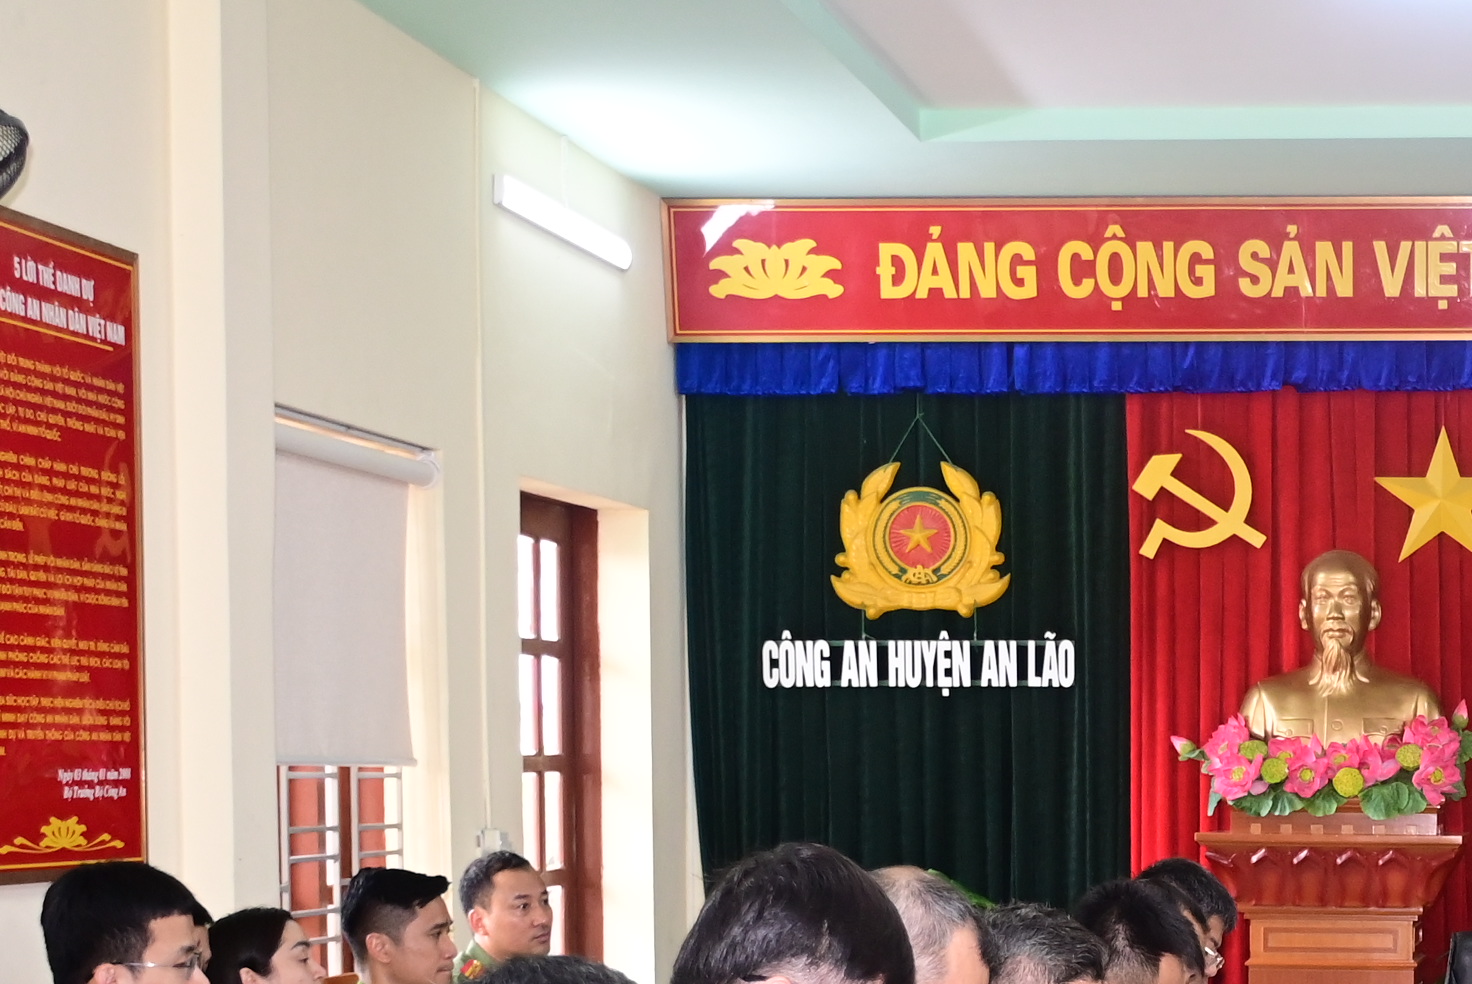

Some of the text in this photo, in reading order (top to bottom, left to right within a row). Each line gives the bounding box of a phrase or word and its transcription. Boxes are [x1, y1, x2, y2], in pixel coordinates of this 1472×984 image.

[14, 255, 21, 279] 5
[875, 226, 1037, 300] ĐẢNG
[1057, 228, 1217, 311] CỘNG
[1238, 224, 1354, 298] SẢN
[0, 285, 26, 317] CÔNG
[27, 296, 41, 321] AN
[106, 320, 126, 346] NAM
[762, 630, 1075, 697] CÔNG AN HUYỆN AN LÃO
